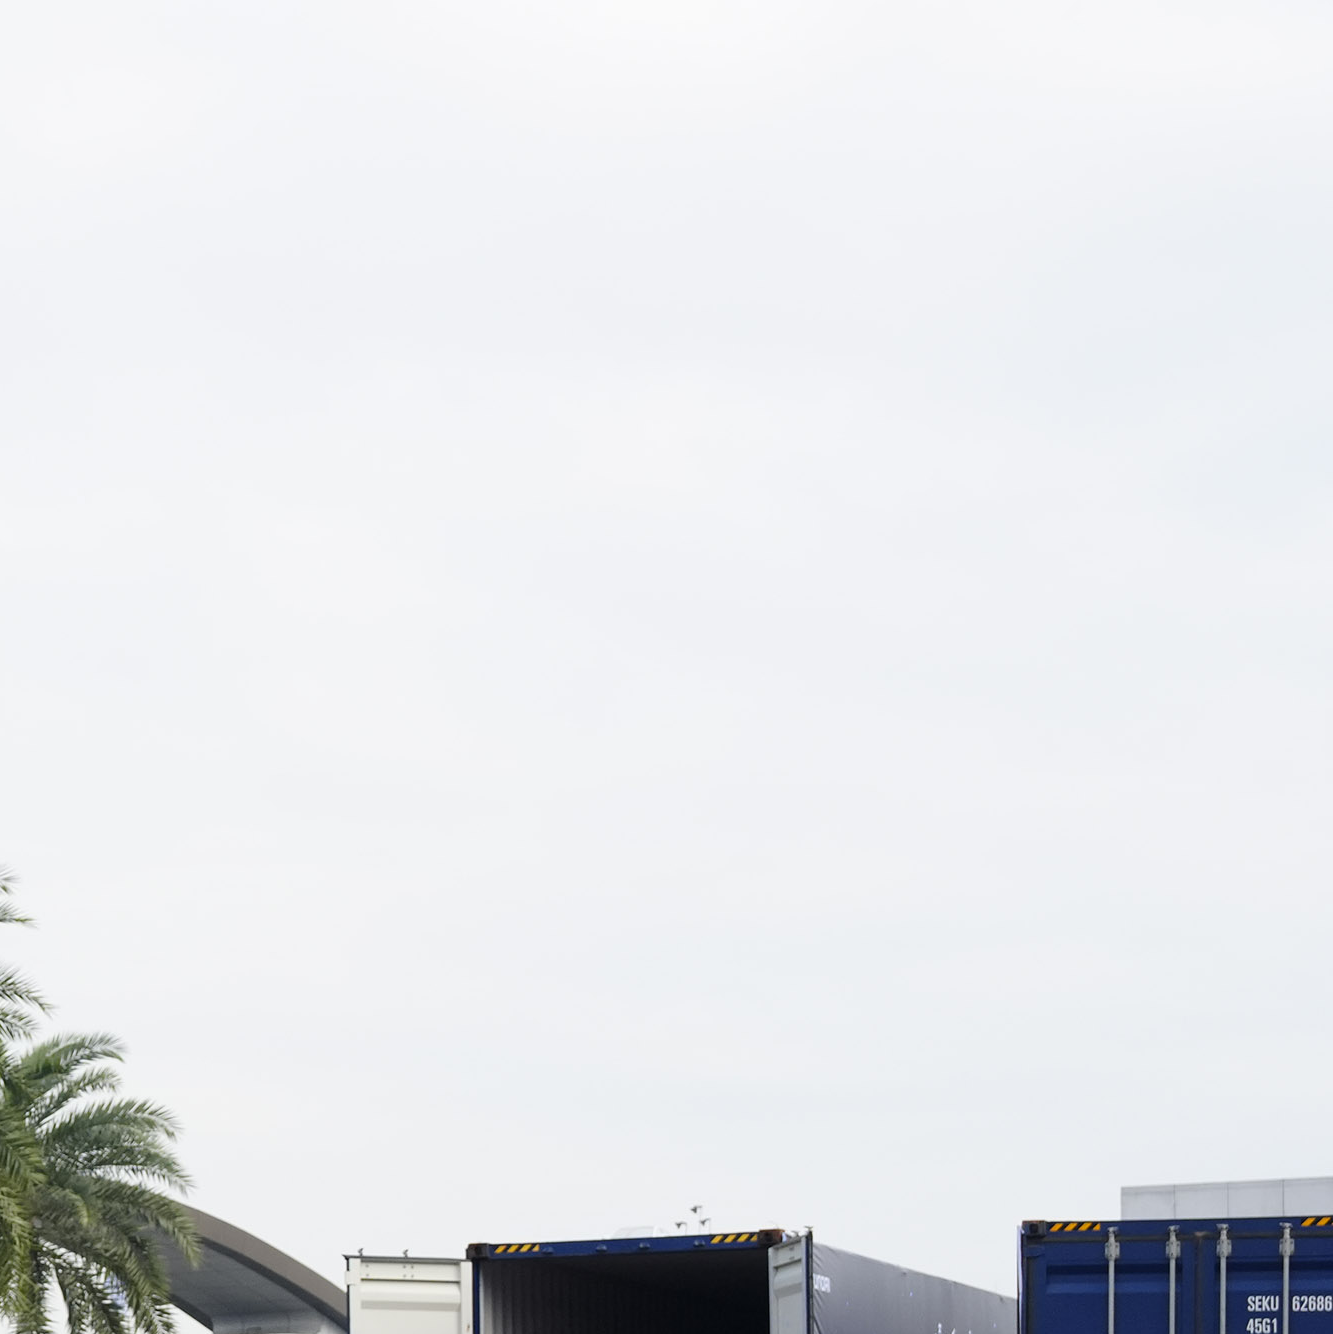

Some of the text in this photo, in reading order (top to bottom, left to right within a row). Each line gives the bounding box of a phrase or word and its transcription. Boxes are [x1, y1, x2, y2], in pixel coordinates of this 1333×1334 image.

[1247, 1295, 1333, 1312] SEKU 62686
[1246, 1317, 1278, 1334] 45G1
